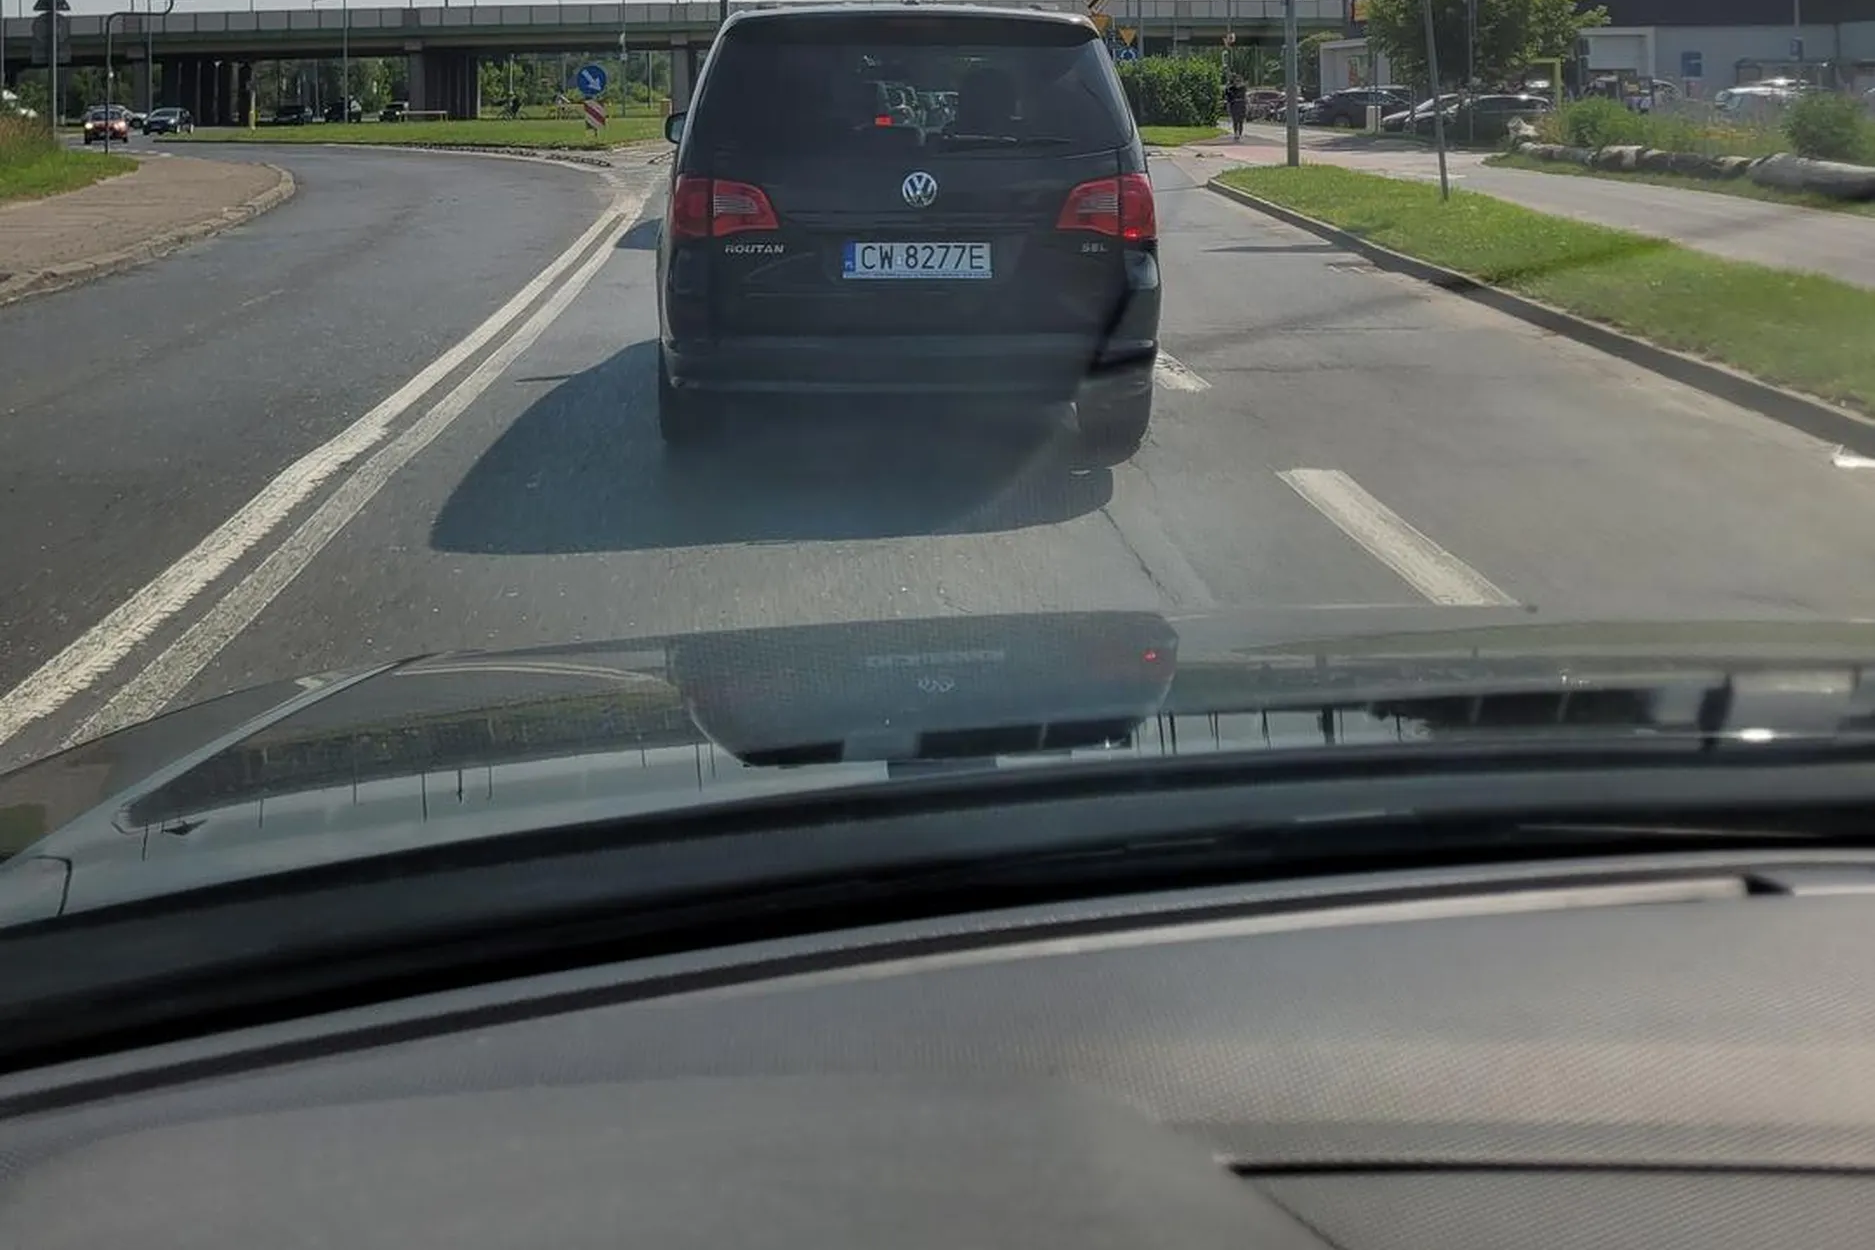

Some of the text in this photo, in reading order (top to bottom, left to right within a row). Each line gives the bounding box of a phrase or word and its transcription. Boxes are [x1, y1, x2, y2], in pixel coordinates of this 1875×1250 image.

[724, 243, 785, 255] ROUTAN
[861, 244, 986, 271] CW 8277E
